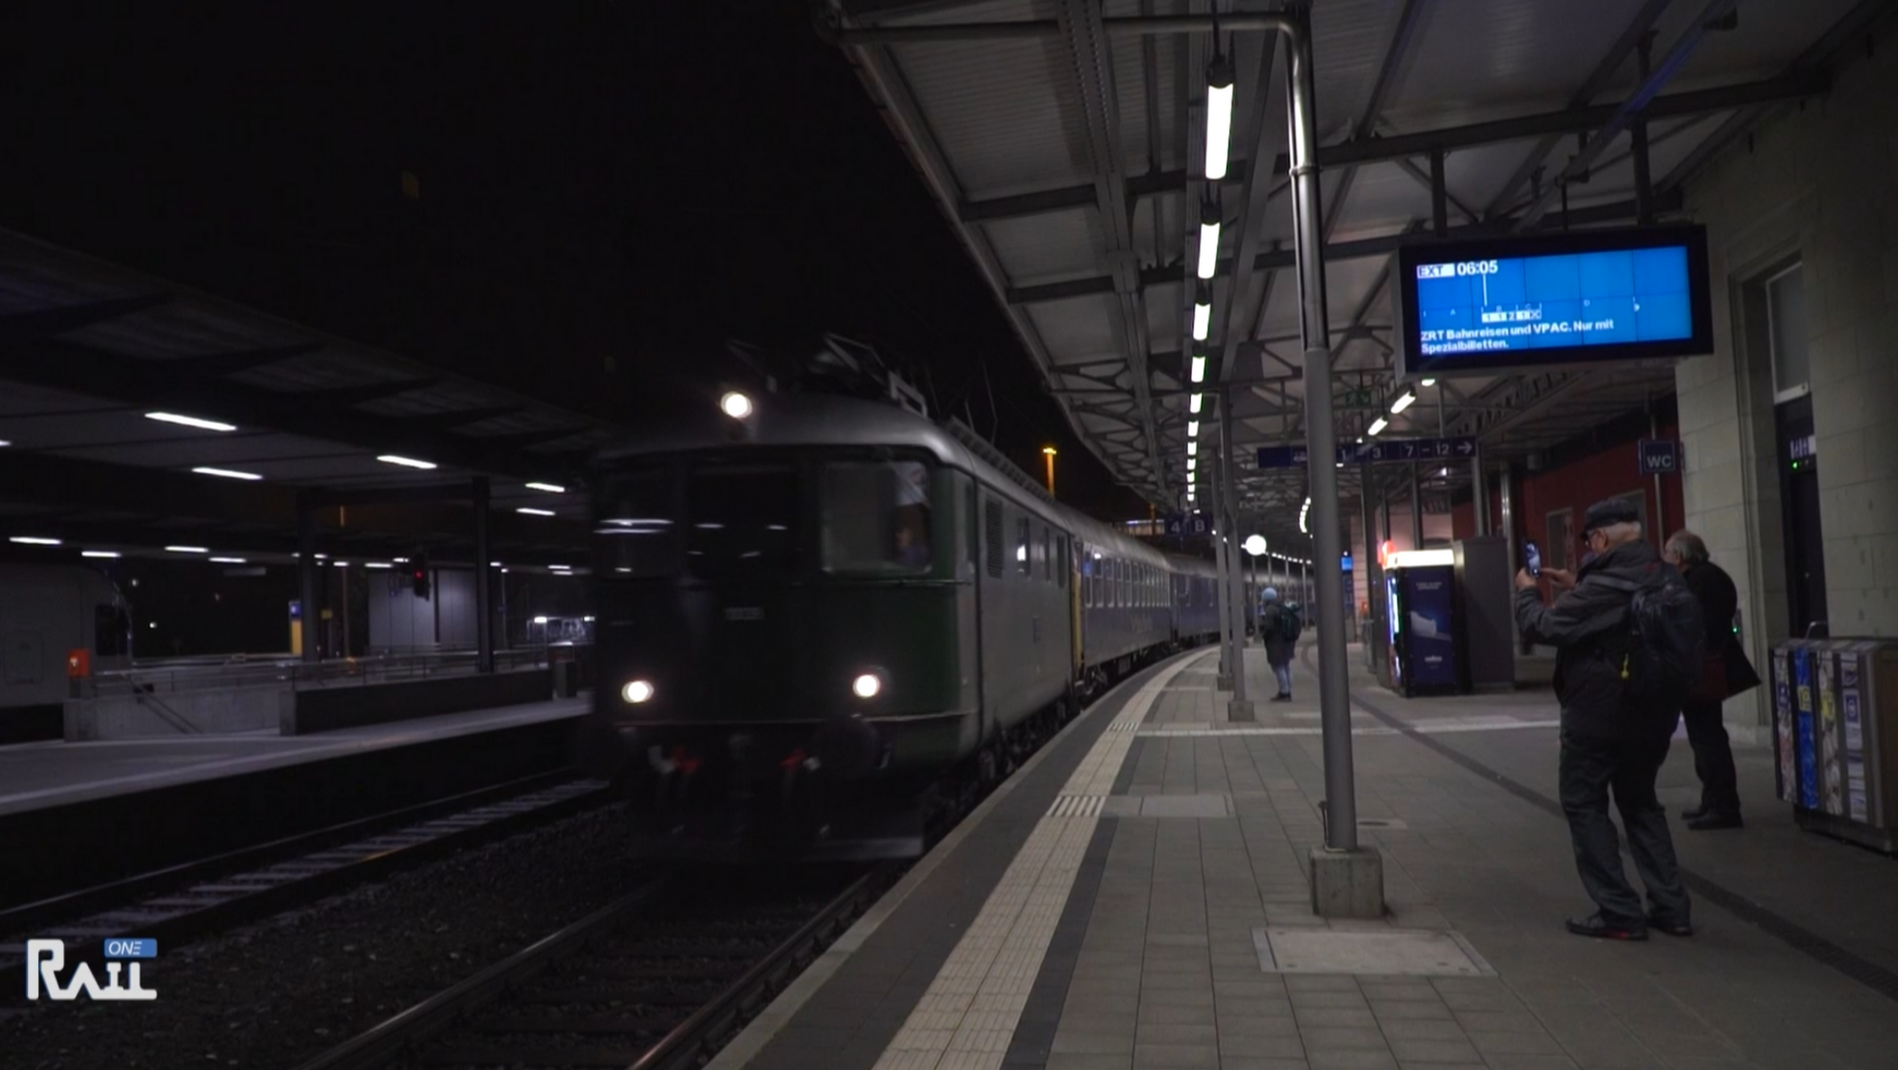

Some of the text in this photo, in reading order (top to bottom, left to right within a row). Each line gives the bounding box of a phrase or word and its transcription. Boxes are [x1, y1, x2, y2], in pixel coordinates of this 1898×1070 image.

[1420, 260, 1498, 278] EXT 06:05
[1421, 318, 1615, 342] ZRT Bahnreisen und VPAC. Nur mit
[1421, 339, 1509, 355] Spezialbilletten.
[1372, 447, 1381, 459] 3
[1405, 444, 1415, 457] 7
[1435, 443, 1450, 456] 12
[1647, 454, 1672, 468] WC
[1194, 519, 1205, 532] B
